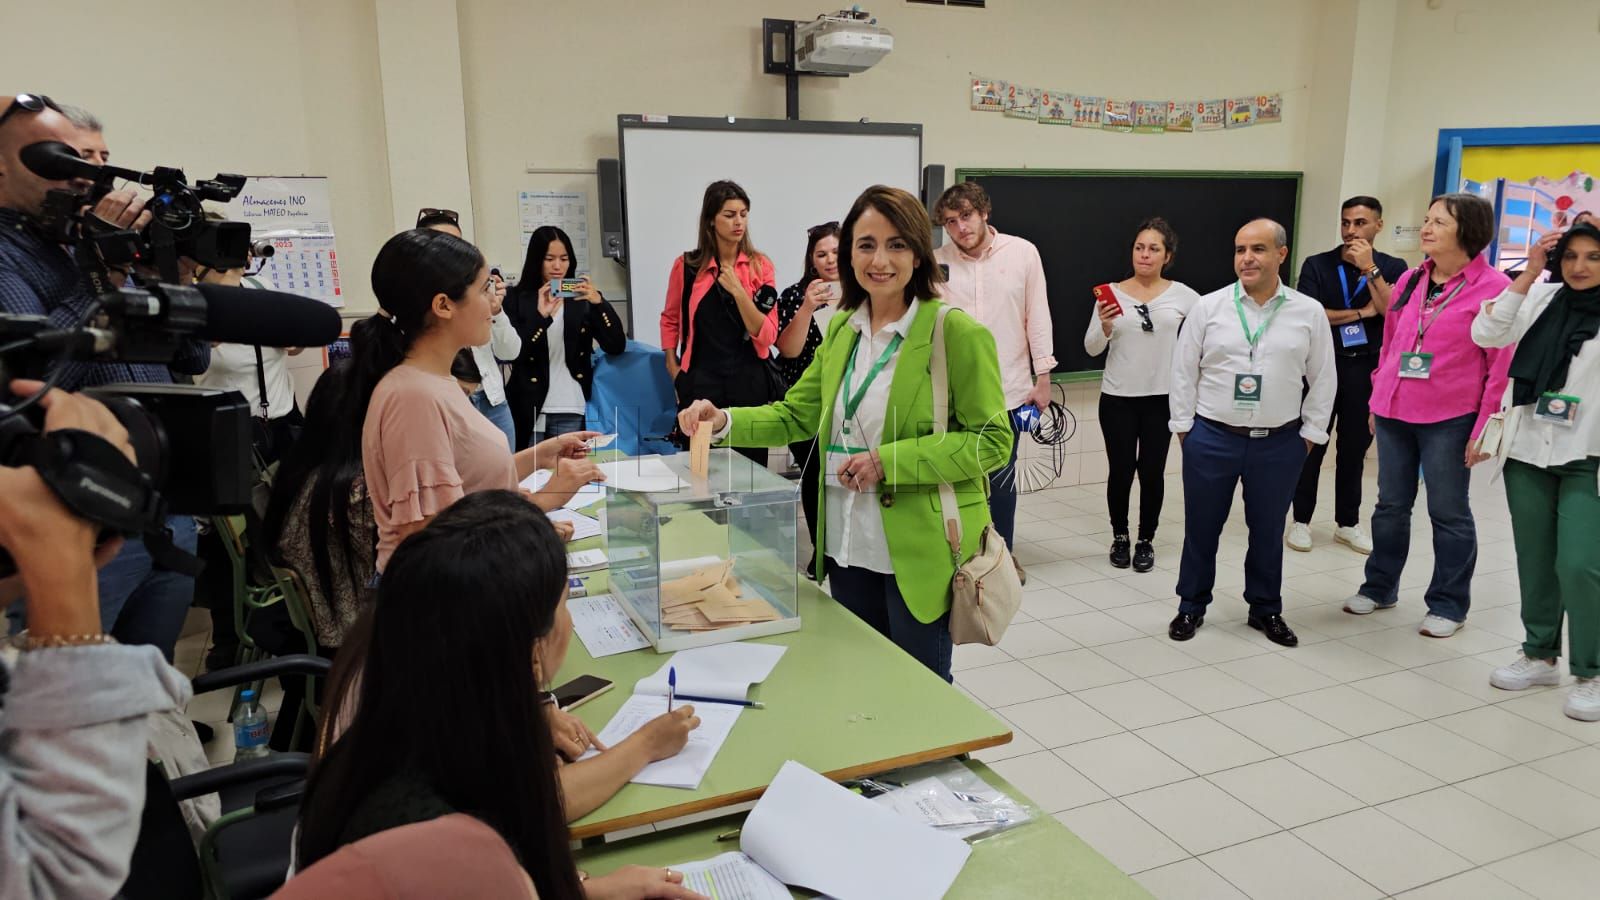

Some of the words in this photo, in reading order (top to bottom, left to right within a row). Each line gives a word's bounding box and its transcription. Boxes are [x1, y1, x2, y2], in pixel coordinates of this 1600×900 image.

[1008, 86, 1015, 98] 2
[1042, 94, 1049, 106] 3
[1073, 98, 1082, 109] 4
[1255, 96, 1267, 107] 10
[1106, 101, 1113, 112] 5
[1138, 104, 1144, 115] 6
[1197, 103, 1204, 114] 8
[1227, 101, 1234, 112] 9
[242, 195, 286, 206] Almacenes
[289, 195, 306, 205] INO
[263, 208, 286, 217] MATEO
